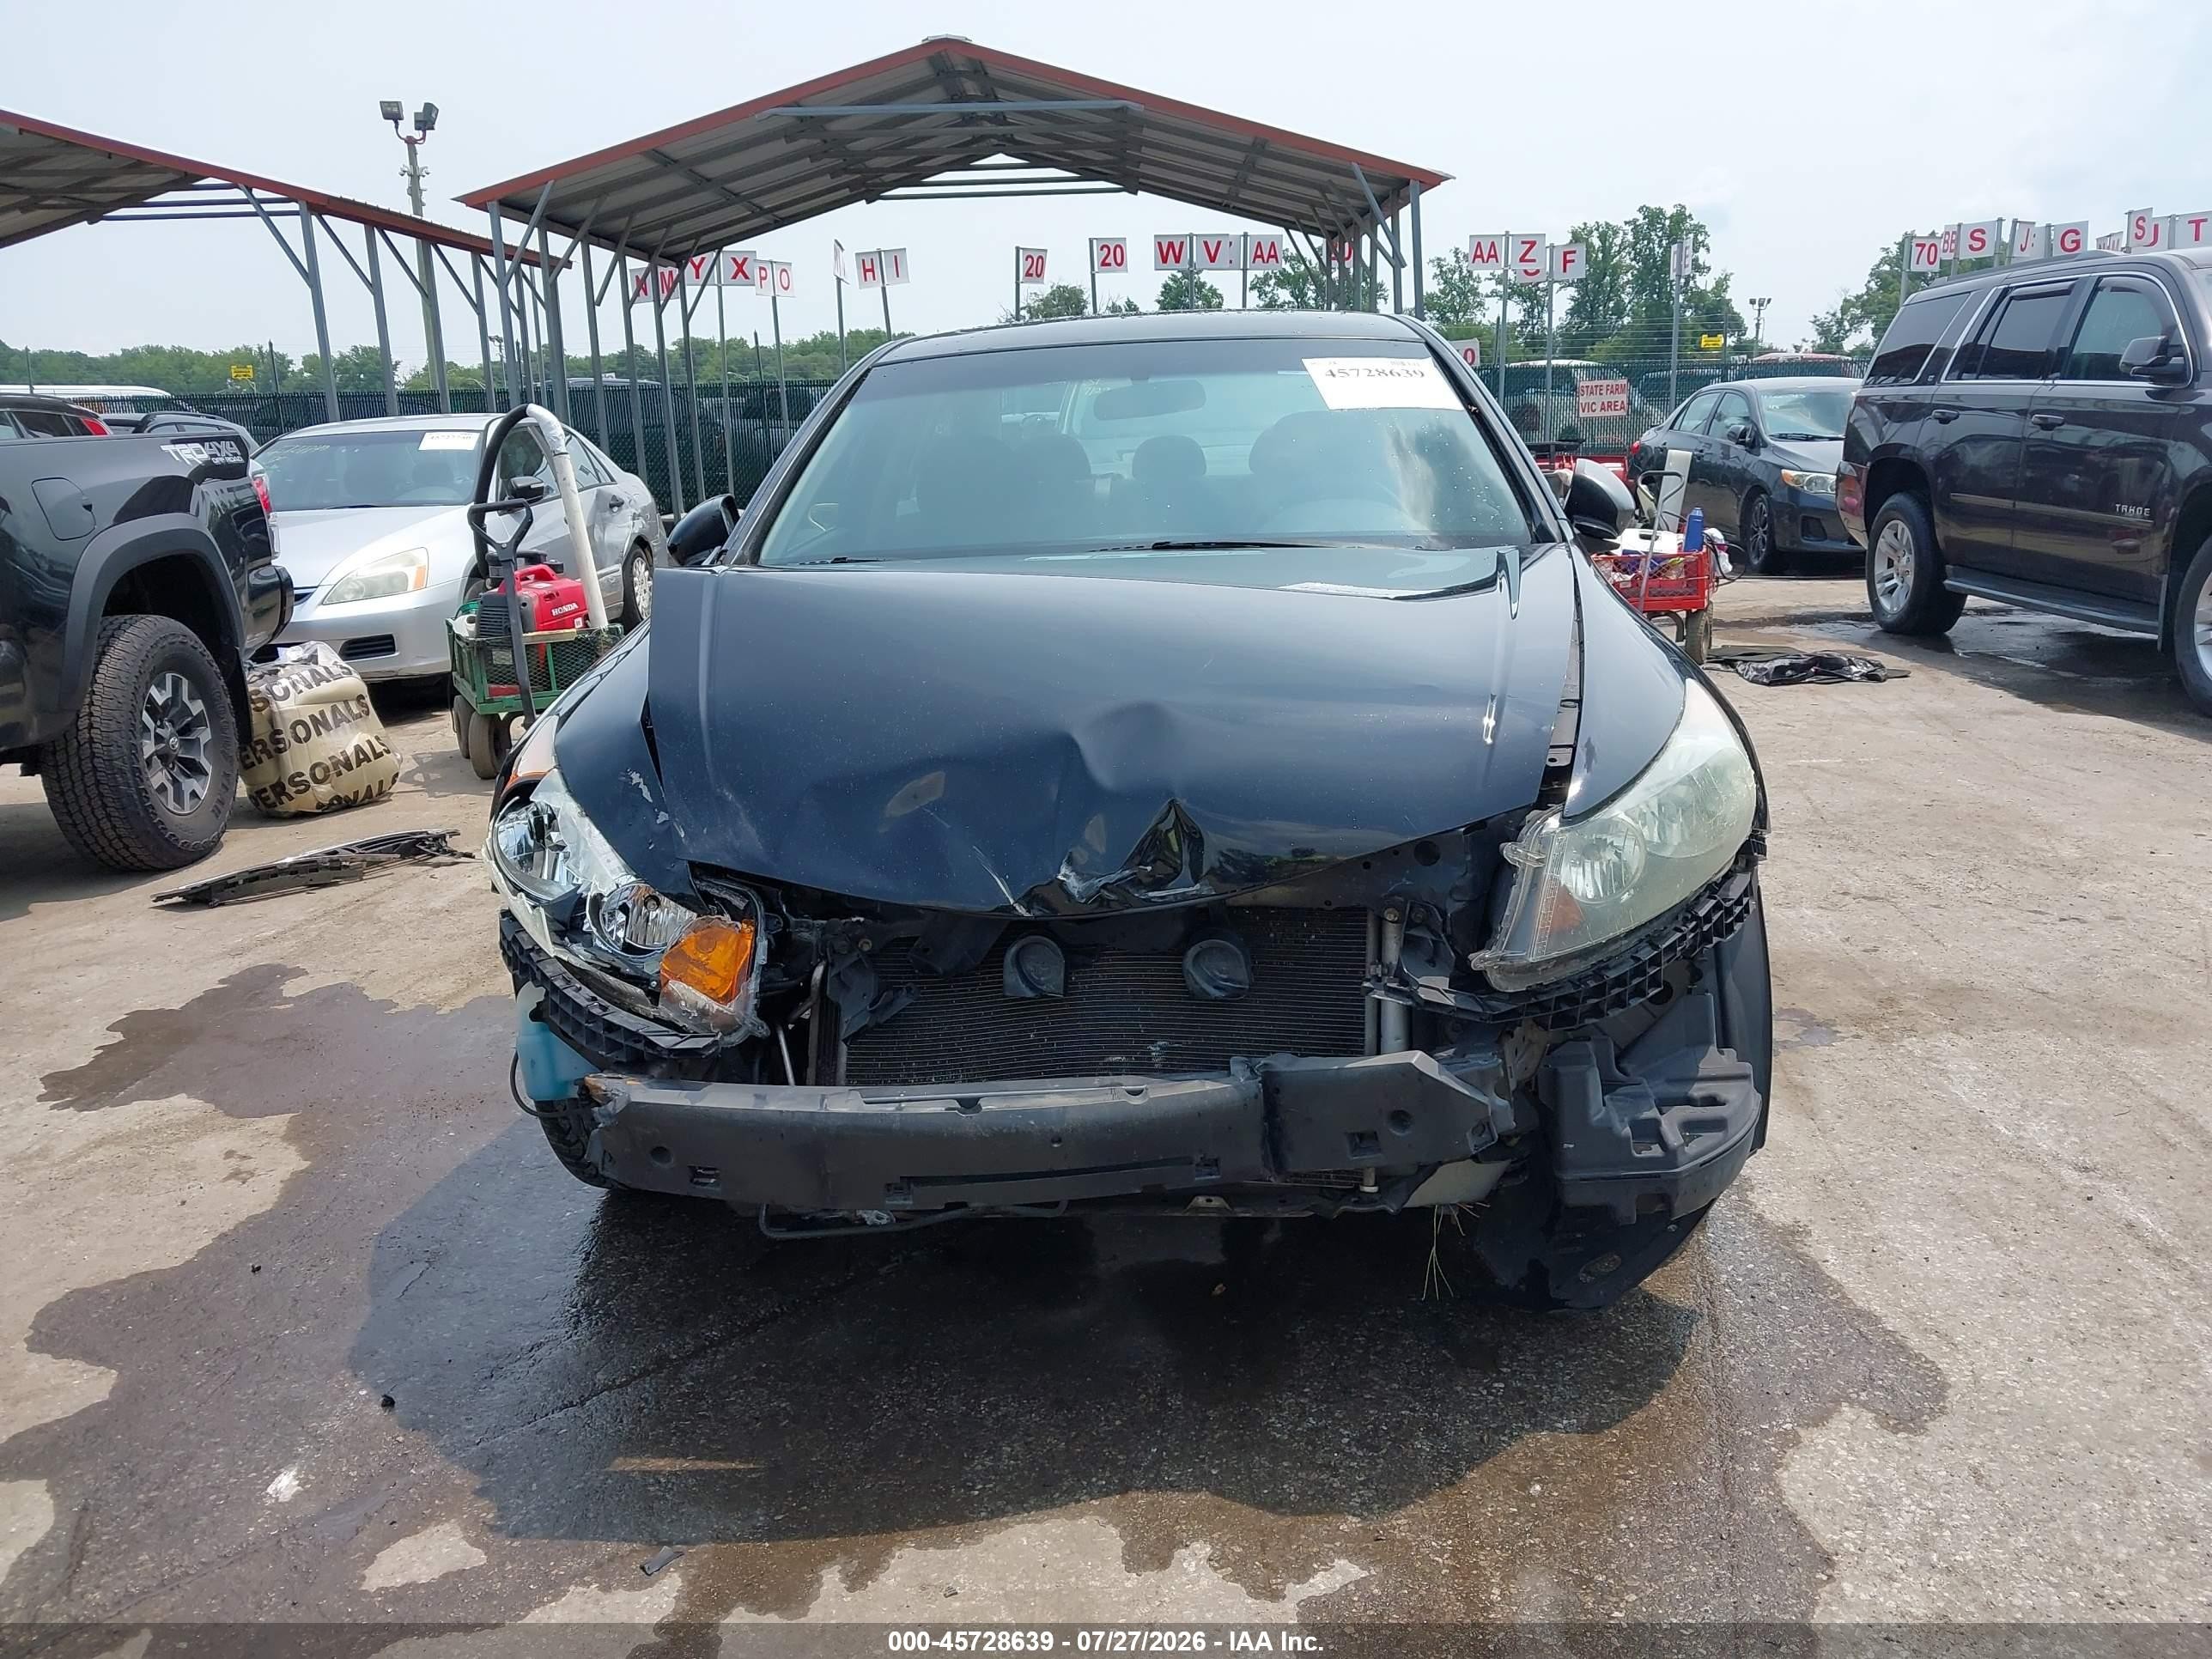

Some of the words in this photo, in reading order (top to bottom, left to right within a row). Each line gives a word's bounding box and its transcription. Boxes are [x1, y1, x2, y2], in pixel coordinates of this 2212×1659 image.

[2135, 216, 2147, 240] S
[2187, 218, 2209, 241] T
[1203, 240, 1222, 263] V
[1518, 240, 1537, 263] Z
[1968, 228, 1986, 252] S
[2020, 228, 2030, 252] J
[2060, 228, 2081, 252] G
[1099, 244, 1125, 267] 20
[1158, 240, 1184, 264] W
[1252, 240, 1279, 264] AA
[1472, 241, 1499, 264] AA
[1562, 250, 1577, 273] F
[1915, 243, 1938, 265] 70
[689, 257, 706, 280] Y
[730, 257, 750, 280] X
[758, 266, 768, 289] P
[861, 258, 877, 282] H
[1024, 254, 1044, 278] 20
[1325, 368, 1425, 378] 45728639
[1580, 385, 1603, 397] STATE
[1606, 383, 1626, 396] FARM
[1580, 402, 1596, 413] VIC
[1600, 400, 1626, 412] AREA
[2115, 503, 2151, 516] TAHOE
[551, 603, 579, 617] HONDA
